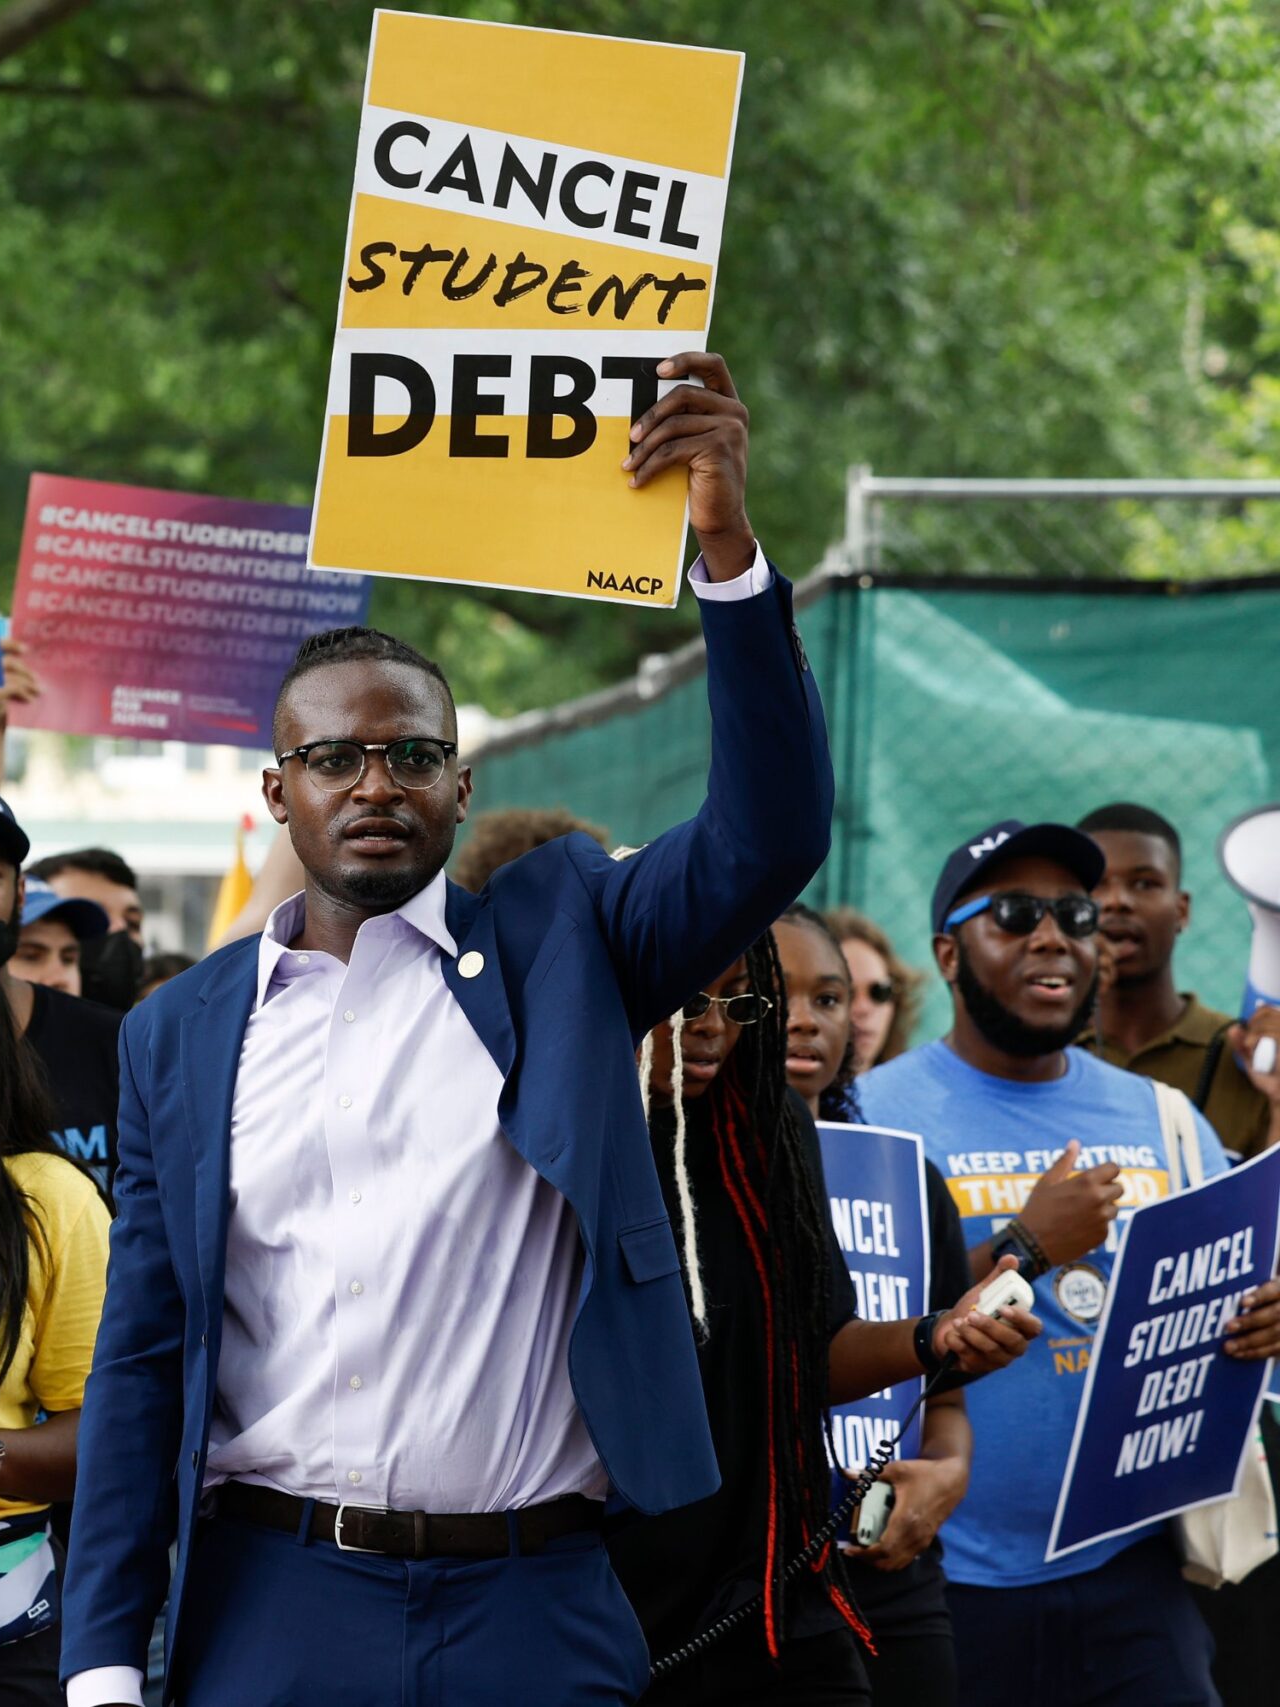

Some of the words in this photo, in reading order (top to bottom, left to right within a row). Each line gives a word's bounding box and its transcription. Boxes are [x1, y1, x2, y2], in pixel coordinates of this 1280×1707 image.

[374, 120, 700, 250] CANCEL
[347, 241, 707, 325] STUDENT
[346, 352, 690, 459] DEBT
[587, 570, 663, 596] NAACP
[946, 1151, 1020, 1176] KEEP
[1147, 1226, 1254, 1306] CANCEL
[1135, 1352, 1216, 1418] DEBT
[1113, 1409, 1205, 1478] NOW!
